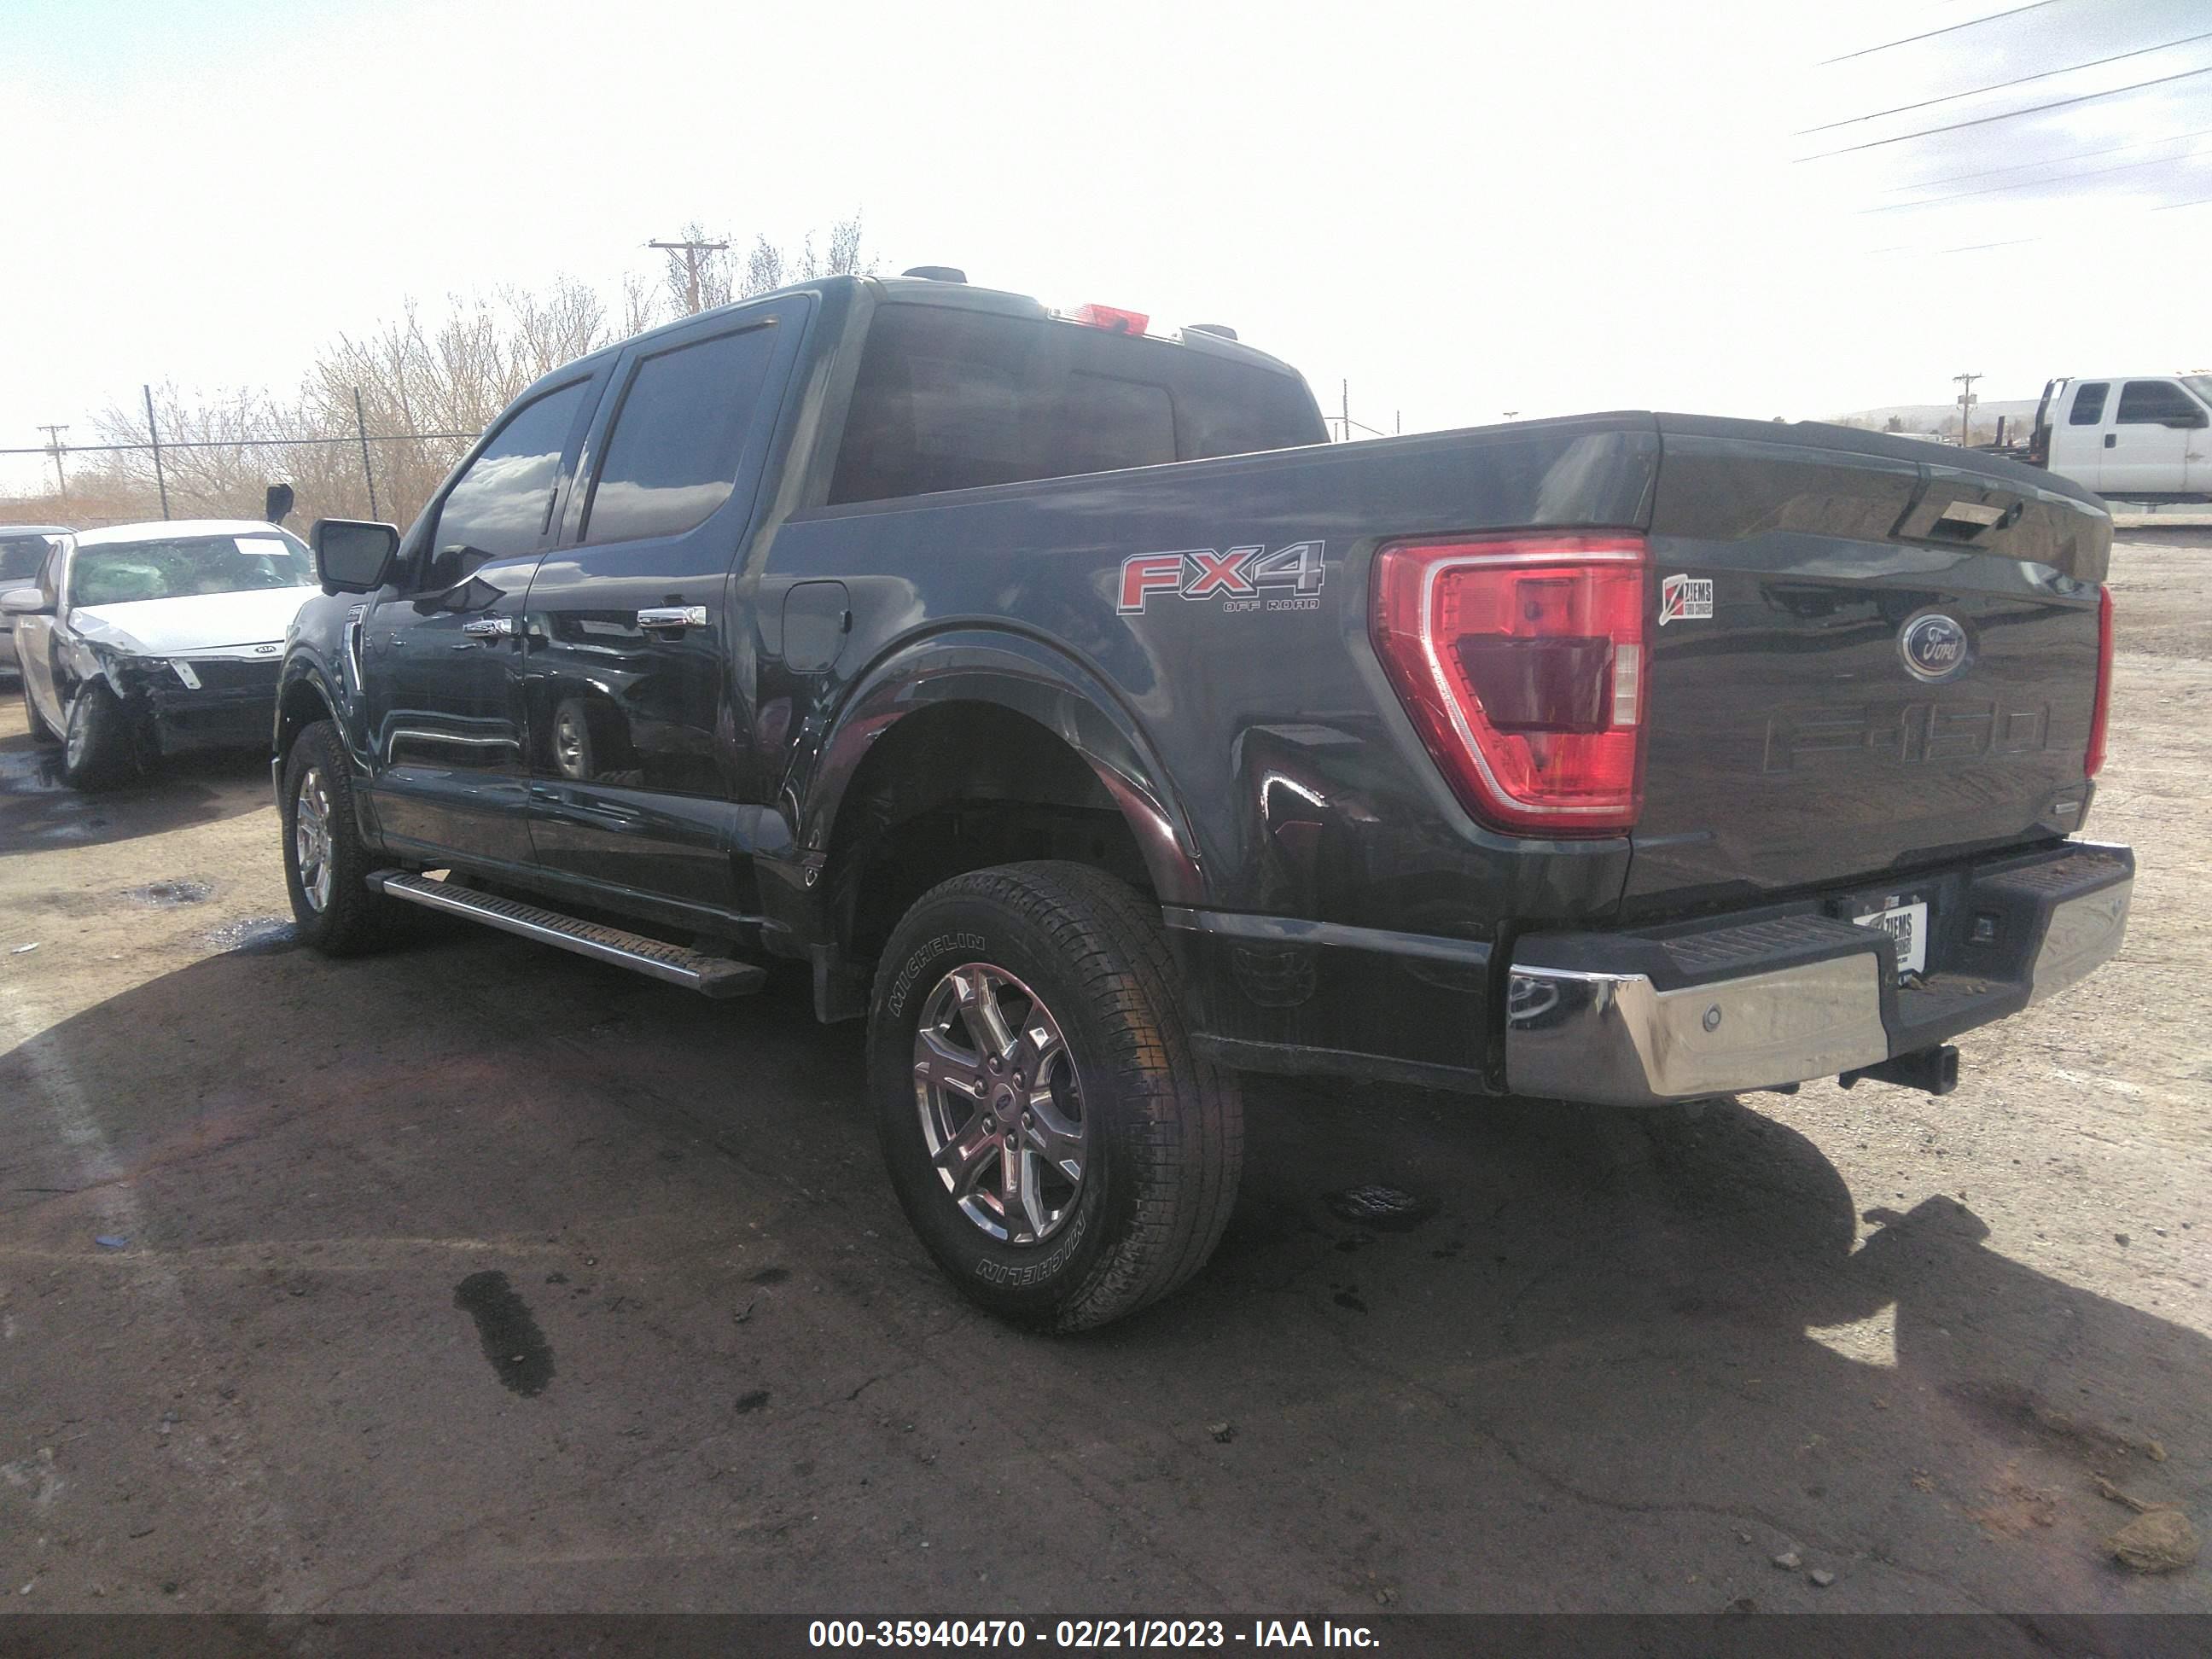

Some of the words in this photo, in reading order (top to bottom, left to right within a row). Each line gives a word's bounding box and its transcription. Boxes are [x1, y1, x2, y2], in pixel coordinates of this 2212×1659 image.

[1116, 540, 1324, 615] FX4
[1685, 582, 1711, 602] ZIEMS
[1223, 601, 1260, 612] OFF
[1266, 599, 1319, 611] ROAD
[1923, 626, 1959, 660] Ford
[888, 933, 985, 1018] MICHELIN
[975, 1208, 1086, 1285] MICHELIN
